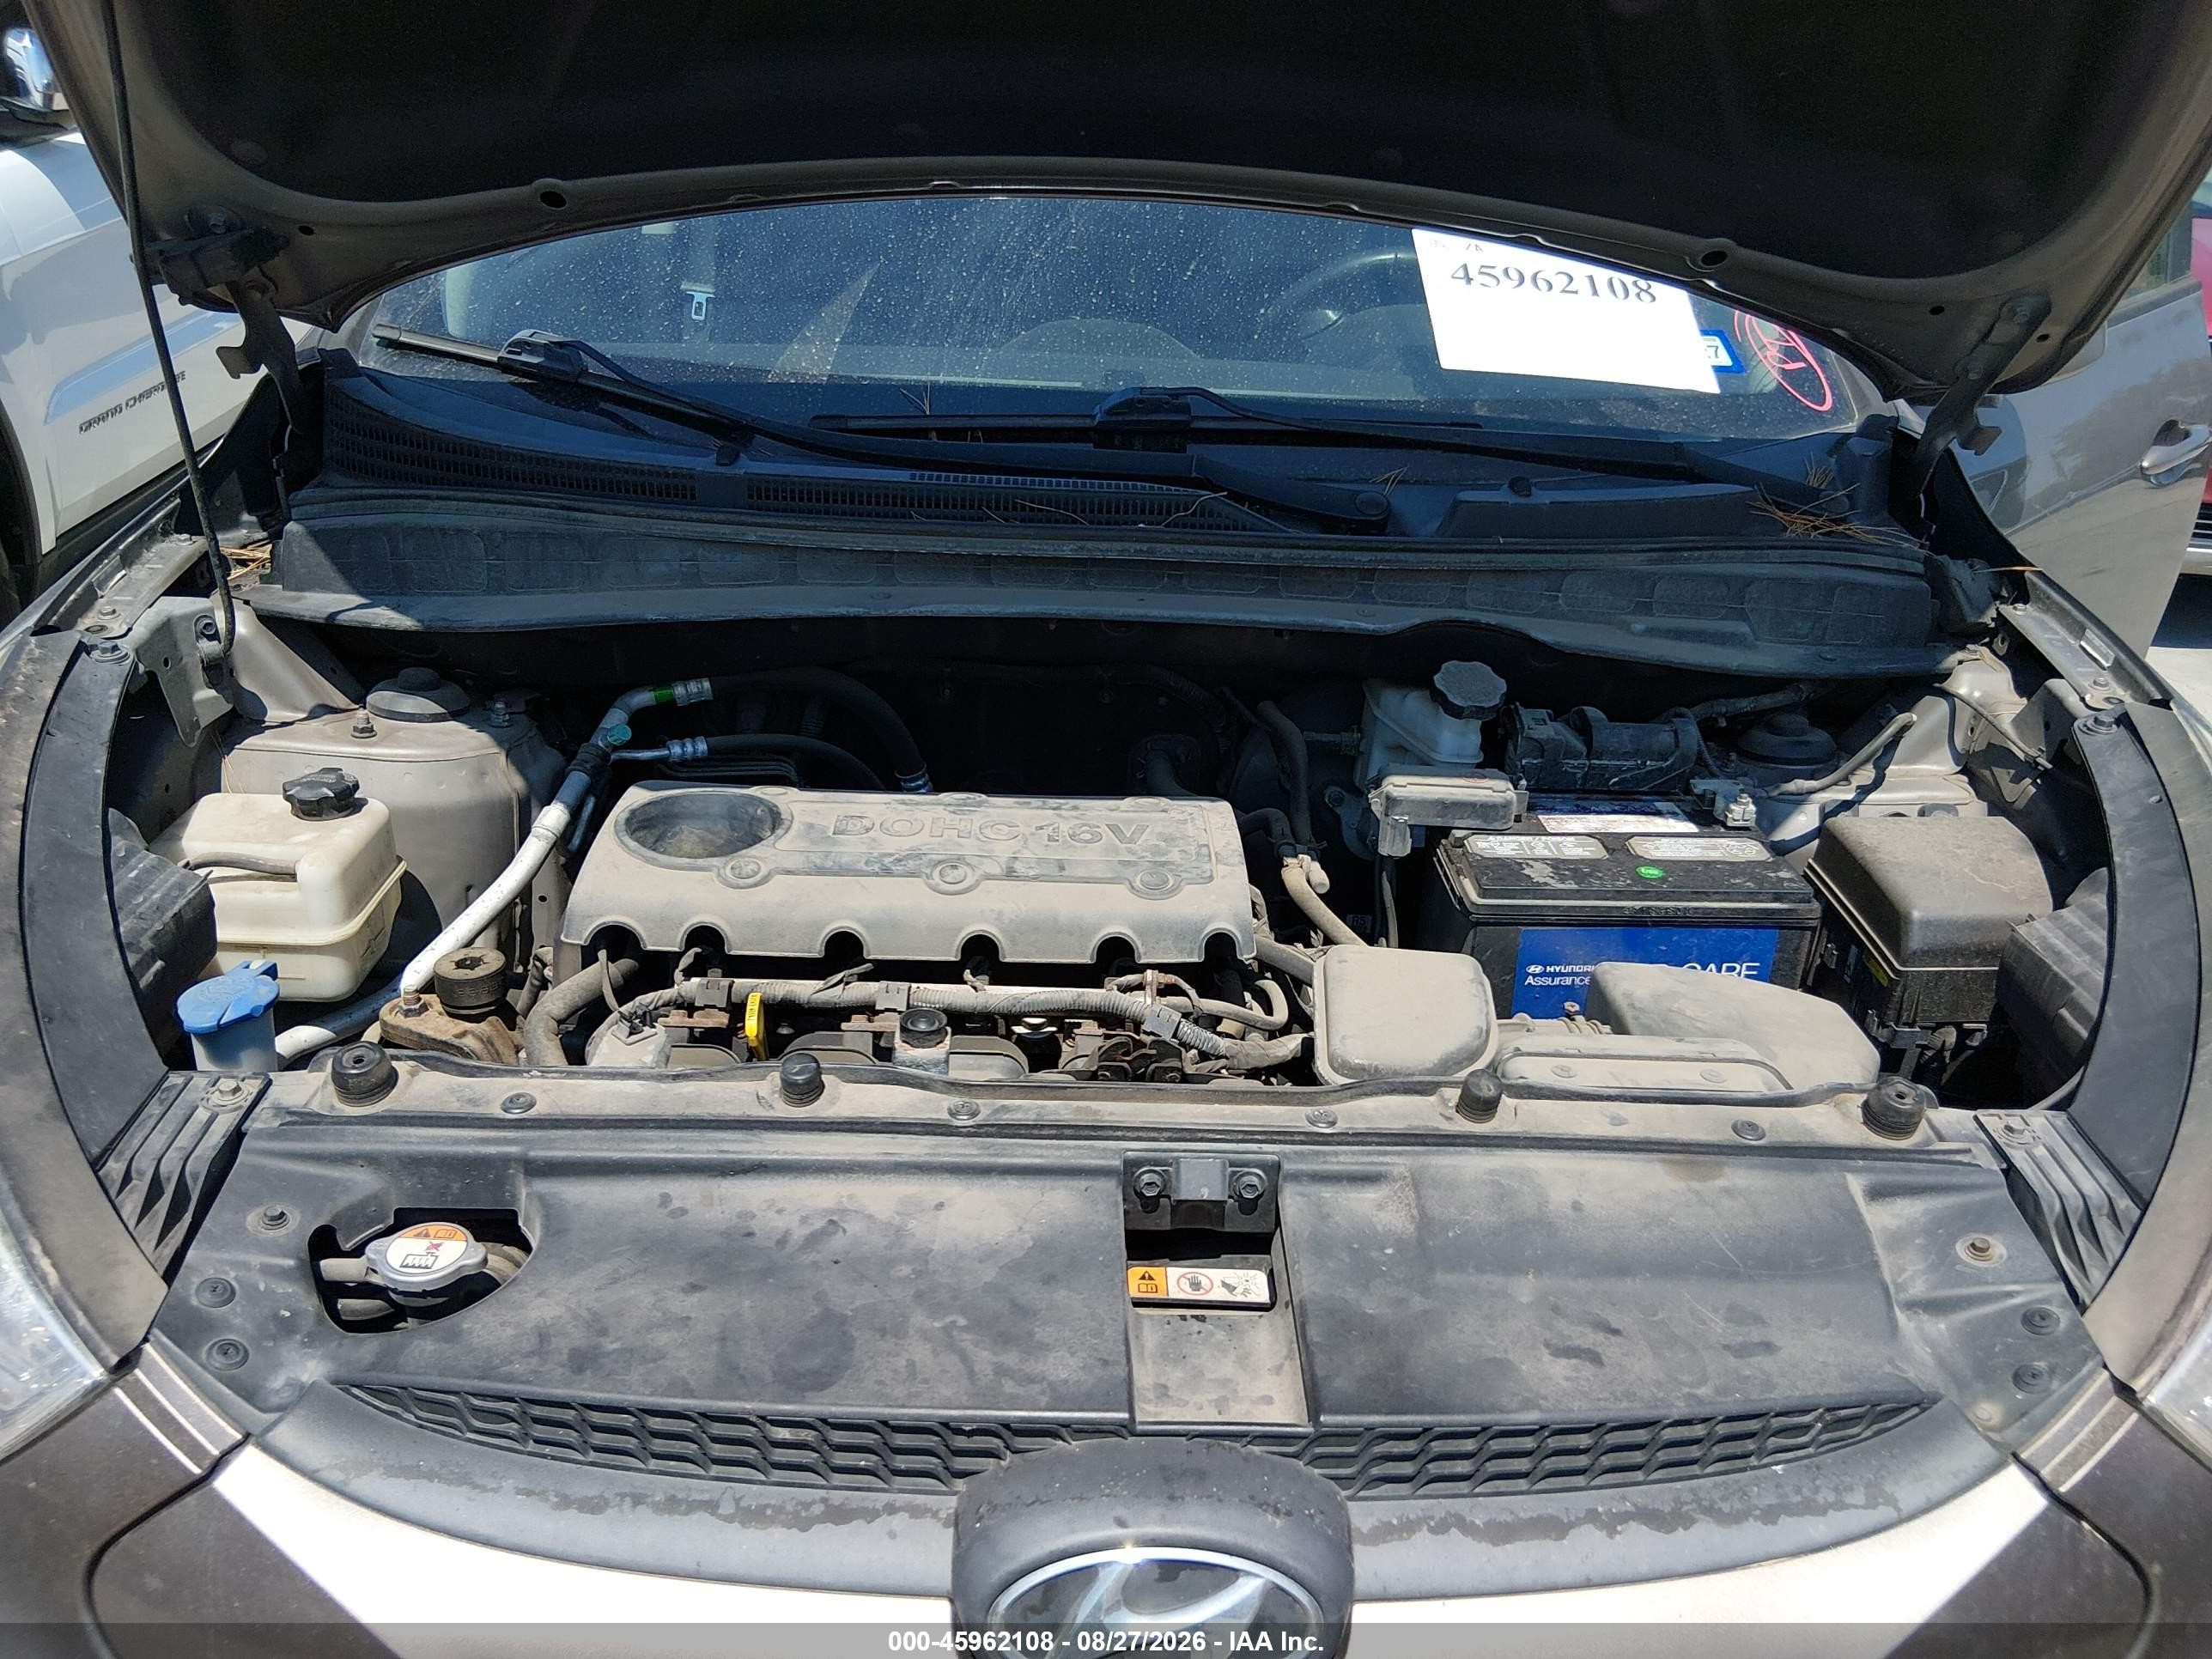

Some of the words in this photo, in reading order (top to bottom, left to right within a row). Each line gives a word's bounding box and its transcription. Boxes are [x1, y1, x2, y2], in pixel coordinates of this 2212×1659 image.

[1450, 262, 1656, 304] 45962108
[1705, 345, 1720, 359] 7
[831, 815, 1021, 842] DOHC
[1034, 820, 1150, 846] 16V
[1524, 975, 1592, 986] Assurance
